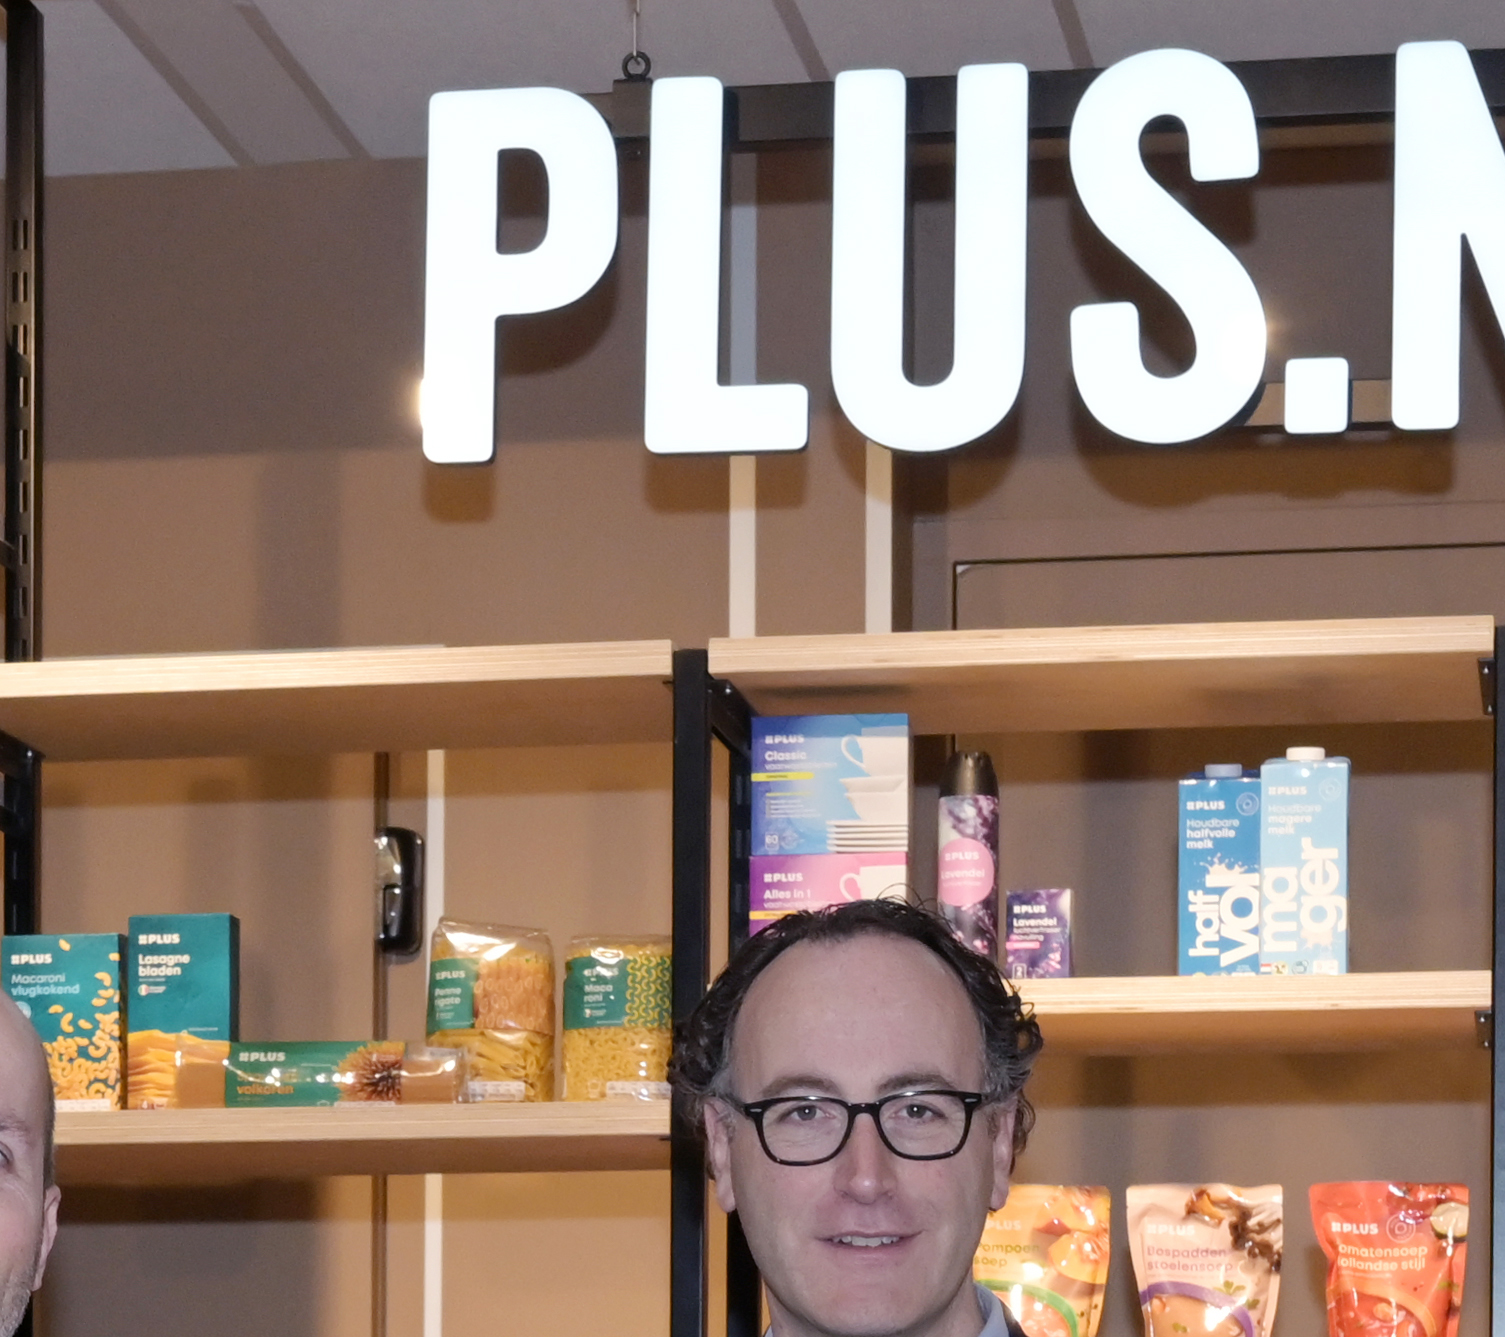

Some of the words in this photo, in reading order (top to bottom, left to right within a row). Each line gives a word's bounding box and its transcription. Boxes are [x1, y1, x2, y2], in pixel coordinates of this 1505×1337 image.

[765, 751, 807, 761] Classic
[1197, 801, 1225, 810] PLUS
[1268, 804, 1321, 813] Houdbare
[1187, 818, 1239, 828] Houdbare
[1268, 814, 1312, 824] magere
[1187, 828, 1236, 838] halfvolle
[1268, 825, 1295, 835] melk
[1187, 839, 1214, 849] melk
[764, 889, 790, 899] Alles
[1013, 918, 1057, 926] Lavendel
[1188, 890, 1220, 957] half
[148, 933, 180, 944] PLUS
[20, 954, 52, 964] PLUS
[138, 954, 190, 966] Lasagne
[138, 965, 182, 977] bladen
[11, 973, 65, 984] Macaroni
[11, 984, 80, 997] vlugkokend
[250, 1052, 286, 1062] PLUS
[1343, 1223, 1379, 1234] PLUS
[1338, 1243, 1428, 1258] omatensoep
[1147, 1260, 1233, 1272] stoelensoep
[1401, 1258, 1425, 1271] stijl
